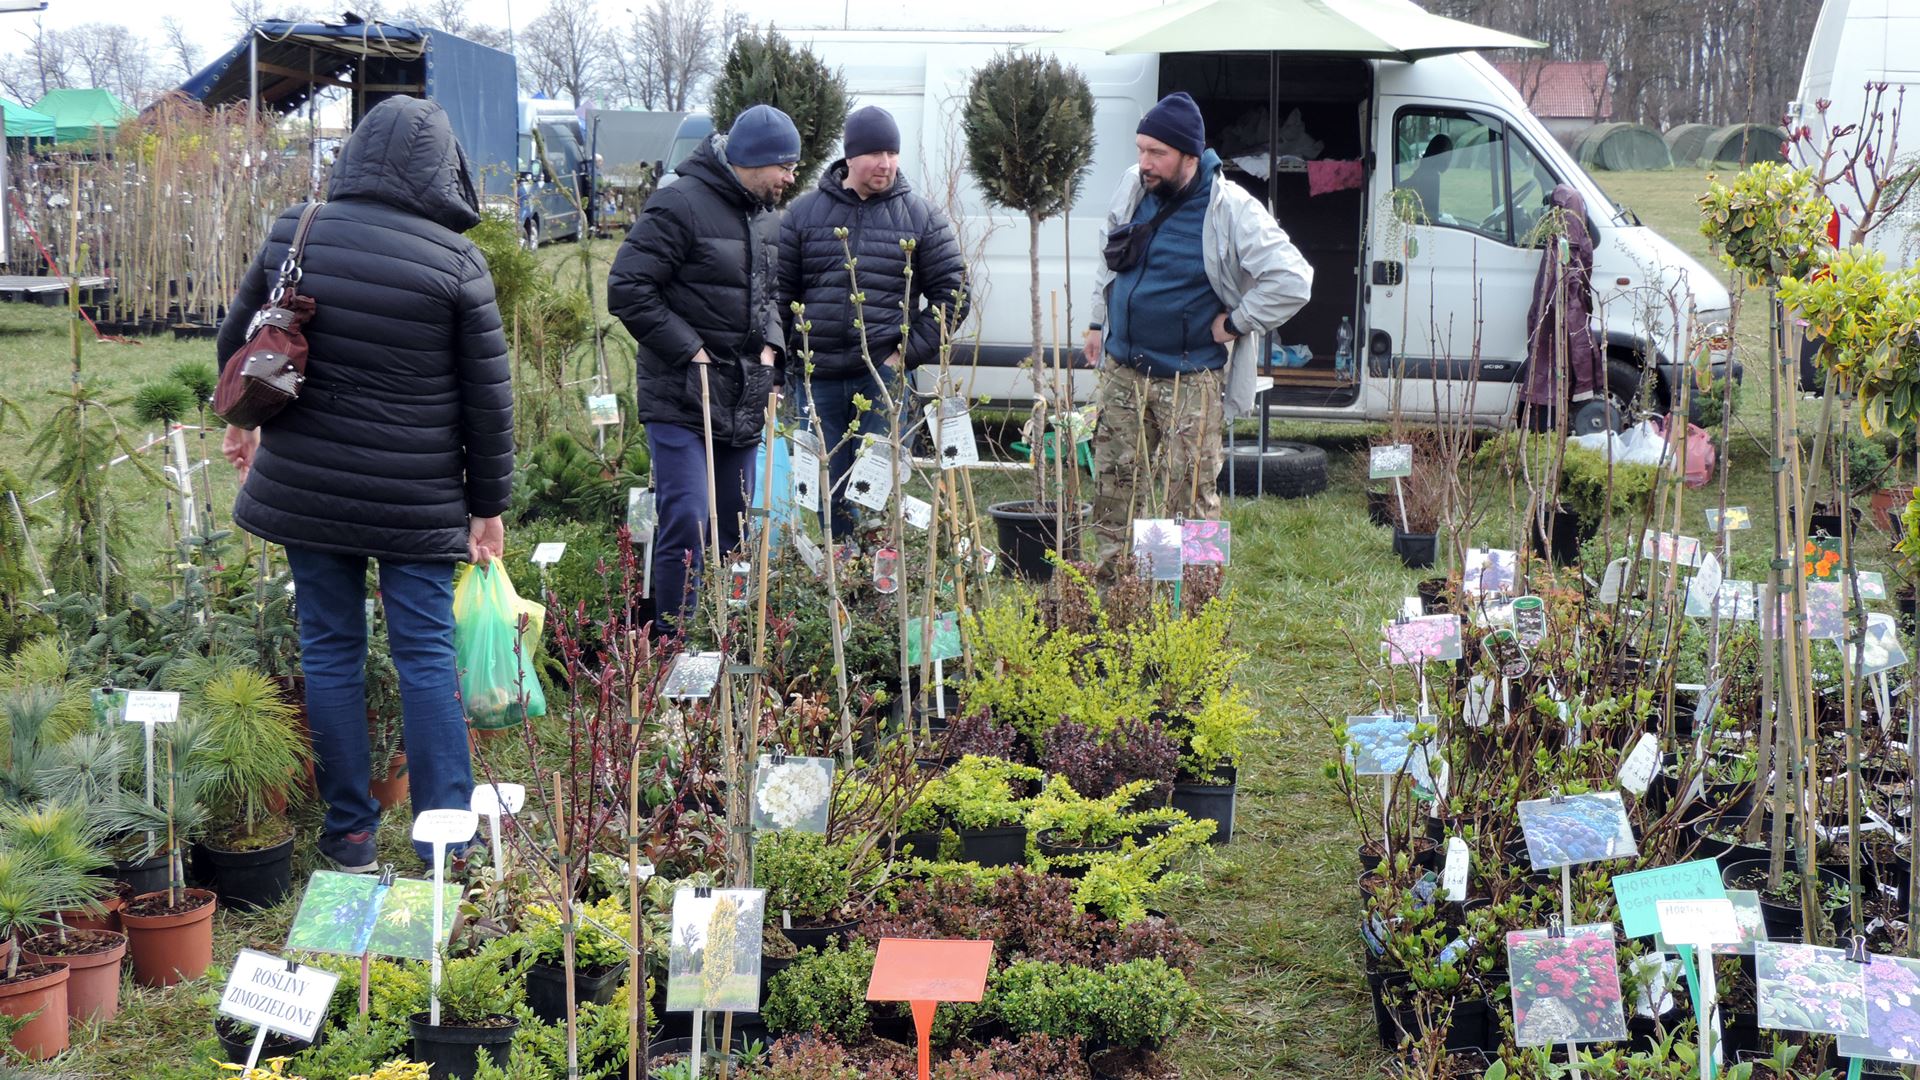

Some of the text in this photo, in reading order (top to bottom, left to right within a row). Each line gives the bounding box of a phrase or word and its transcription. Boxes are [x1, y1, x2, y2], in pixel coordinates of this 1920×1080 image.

[1619, 867, 1713, 895] HORTENSJA
[251, 967, 309, 996] ROŚLINY
[227, 986, 316, 1027] ZIMOZIELONE
